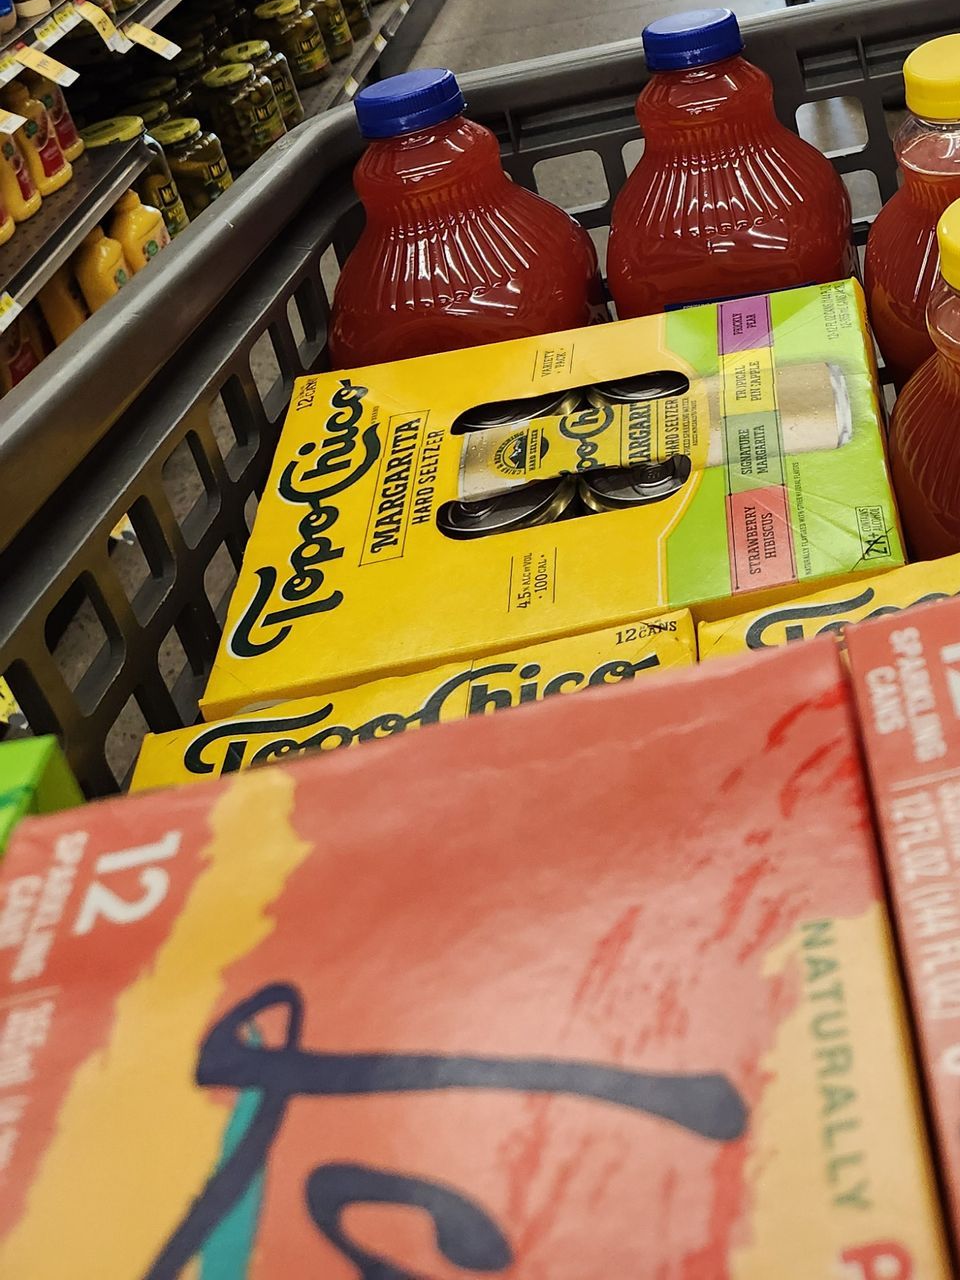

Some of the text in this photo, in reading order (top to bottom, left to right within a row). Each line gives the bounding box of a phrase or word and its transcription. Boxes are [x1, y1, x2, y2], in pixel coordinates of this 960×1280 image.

[746, 313, 757, 328] PEAR
[541, 351, 554, 377] VARIETY
[555, 352, 566, 368] PACK
[296, 396, 314, 412] 12
[666, 397, 680, 432] SELTZER
[628, 401, 652, 468] ARGARIT
[741, 428, 752, 475] SIGNATURE
[757, 424, 768, 474] MARGARITA
[370, 418, 422, 554] MARGARITA
[411, 429, 445, 526] HARD SELTZER
[231, 379, 381, 658] Topo Chico
[749, 505, 761, 575] STRAWBERRY
[765, 512, 777, 558] HIBISCUS
[522, 573, 531, 586] ALC
[803, 548, 811, 575] NATURALLY
[615, 620, 678, 646] 12 CANS
[866, 666, 906, 735] CANS
[889, 626, 948, 763] SPARKLING
[10, 830, 90, 984] SPARKLING
[73, 830, 183, 936] 12
[801, 918, 875, 1211] NATURALLY
